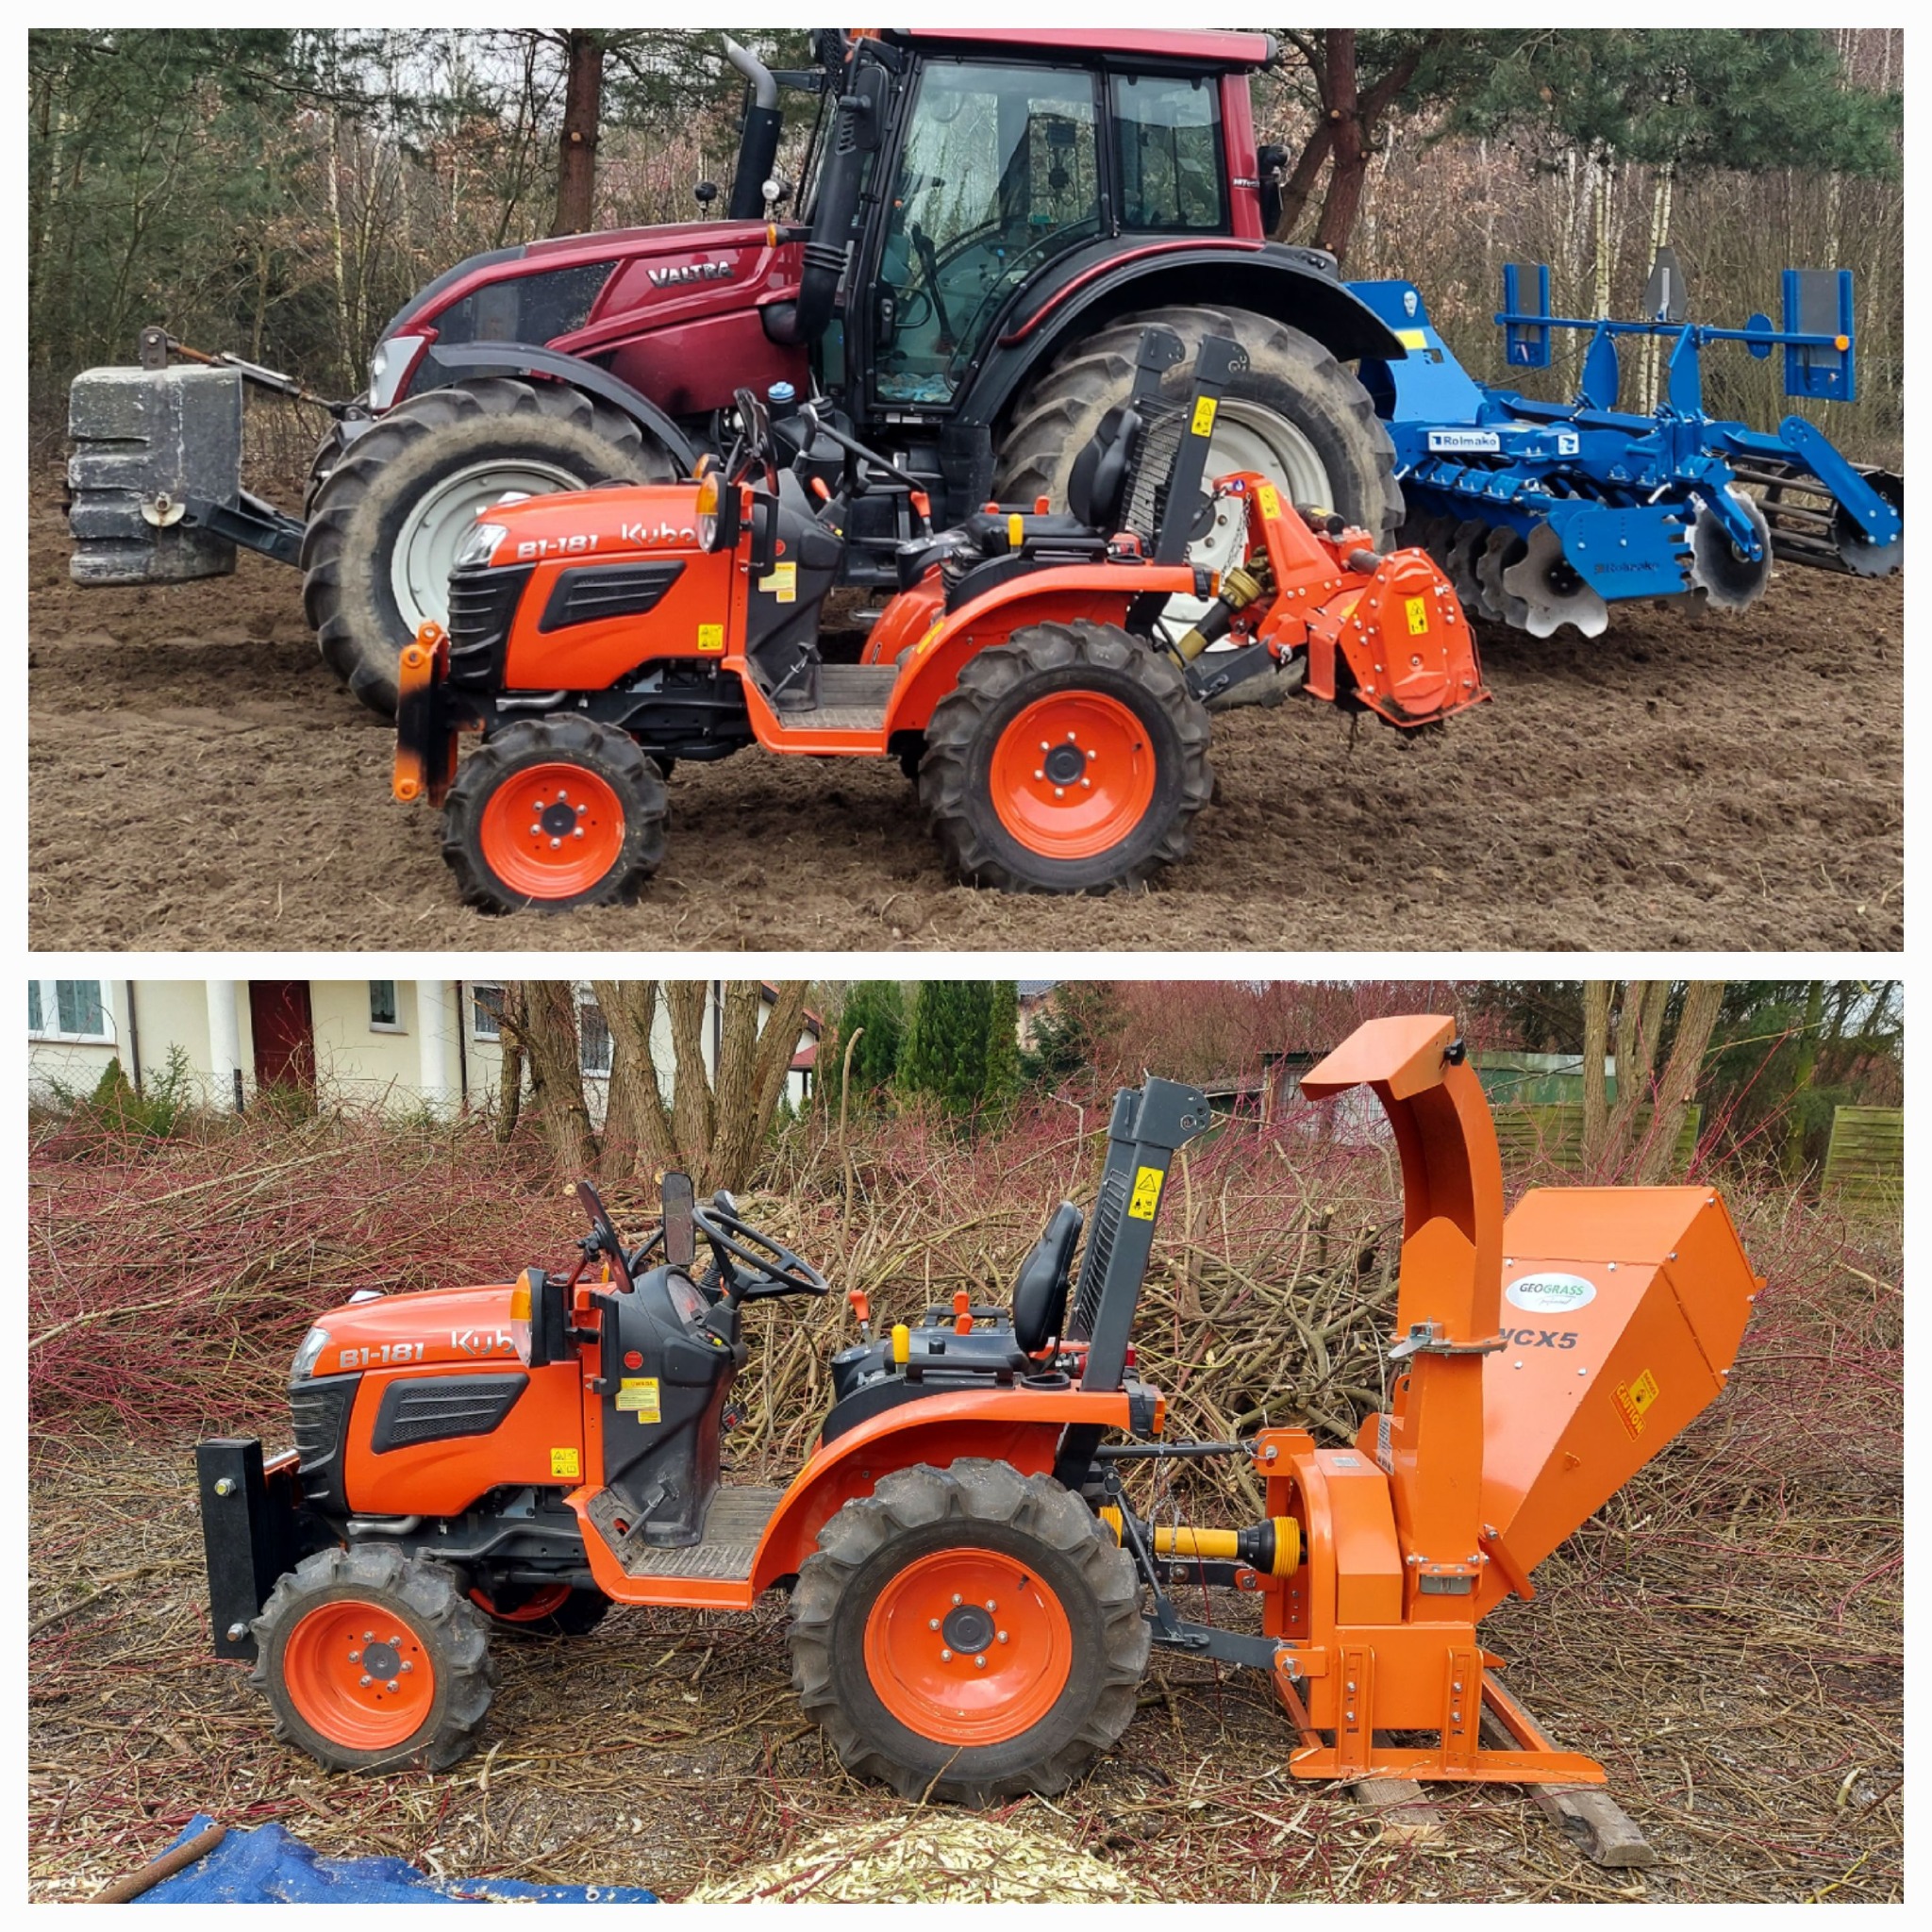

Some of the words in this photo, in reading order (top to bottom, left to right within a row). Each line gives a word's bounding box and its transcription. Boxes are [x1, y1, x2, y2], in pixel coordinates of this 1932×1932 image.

[645, 260, 733, 288] VALTRA
[1443, 435, 1497, 446] Rolmako
[517, 534, 598, 558] B1-181
[1519, 1283, 1585, 1296] GEOGRASS
[340, 1342, 424, 1368] B1-181
[1616, 1384, 1644, 1433] CAUTION
